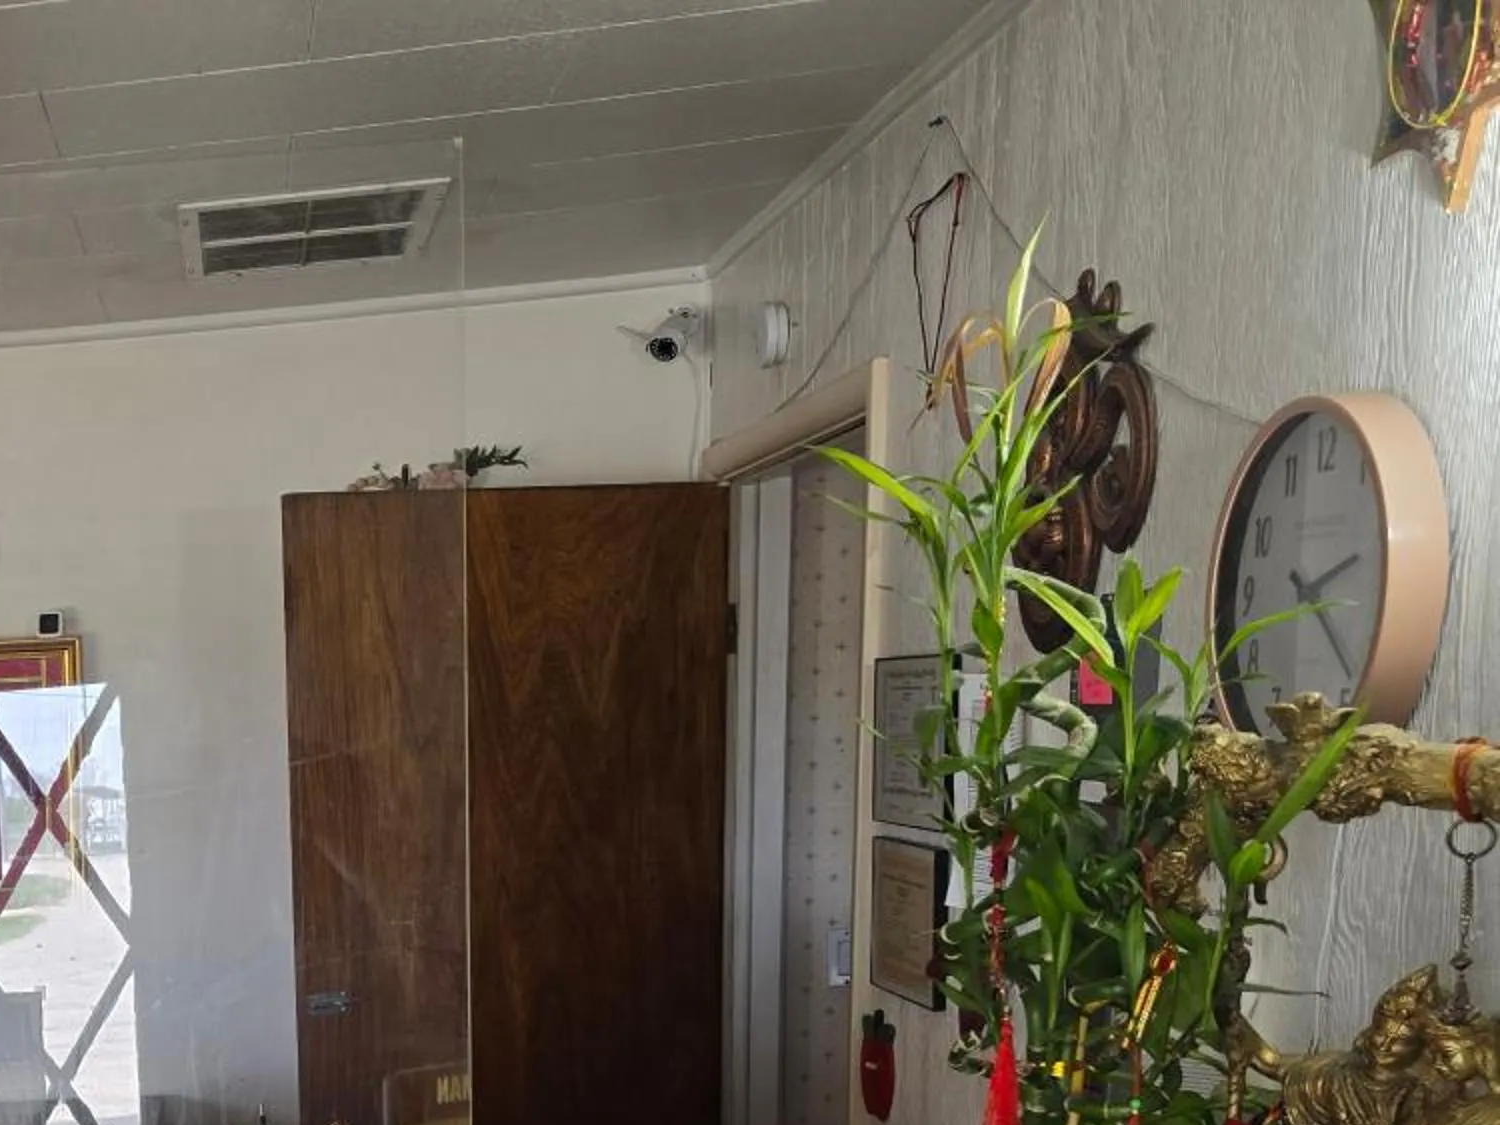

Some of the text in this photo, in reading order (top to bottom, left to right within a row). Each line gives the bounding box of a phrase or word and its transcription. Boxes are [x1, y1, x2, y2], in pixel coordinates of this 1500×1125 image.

[1318, 425, 1337, 474] 12
[1285, 453, 1298, 497] 11
[1254, 516, 1272, 559] 10
[1243, 575, 1255, 617] 9
